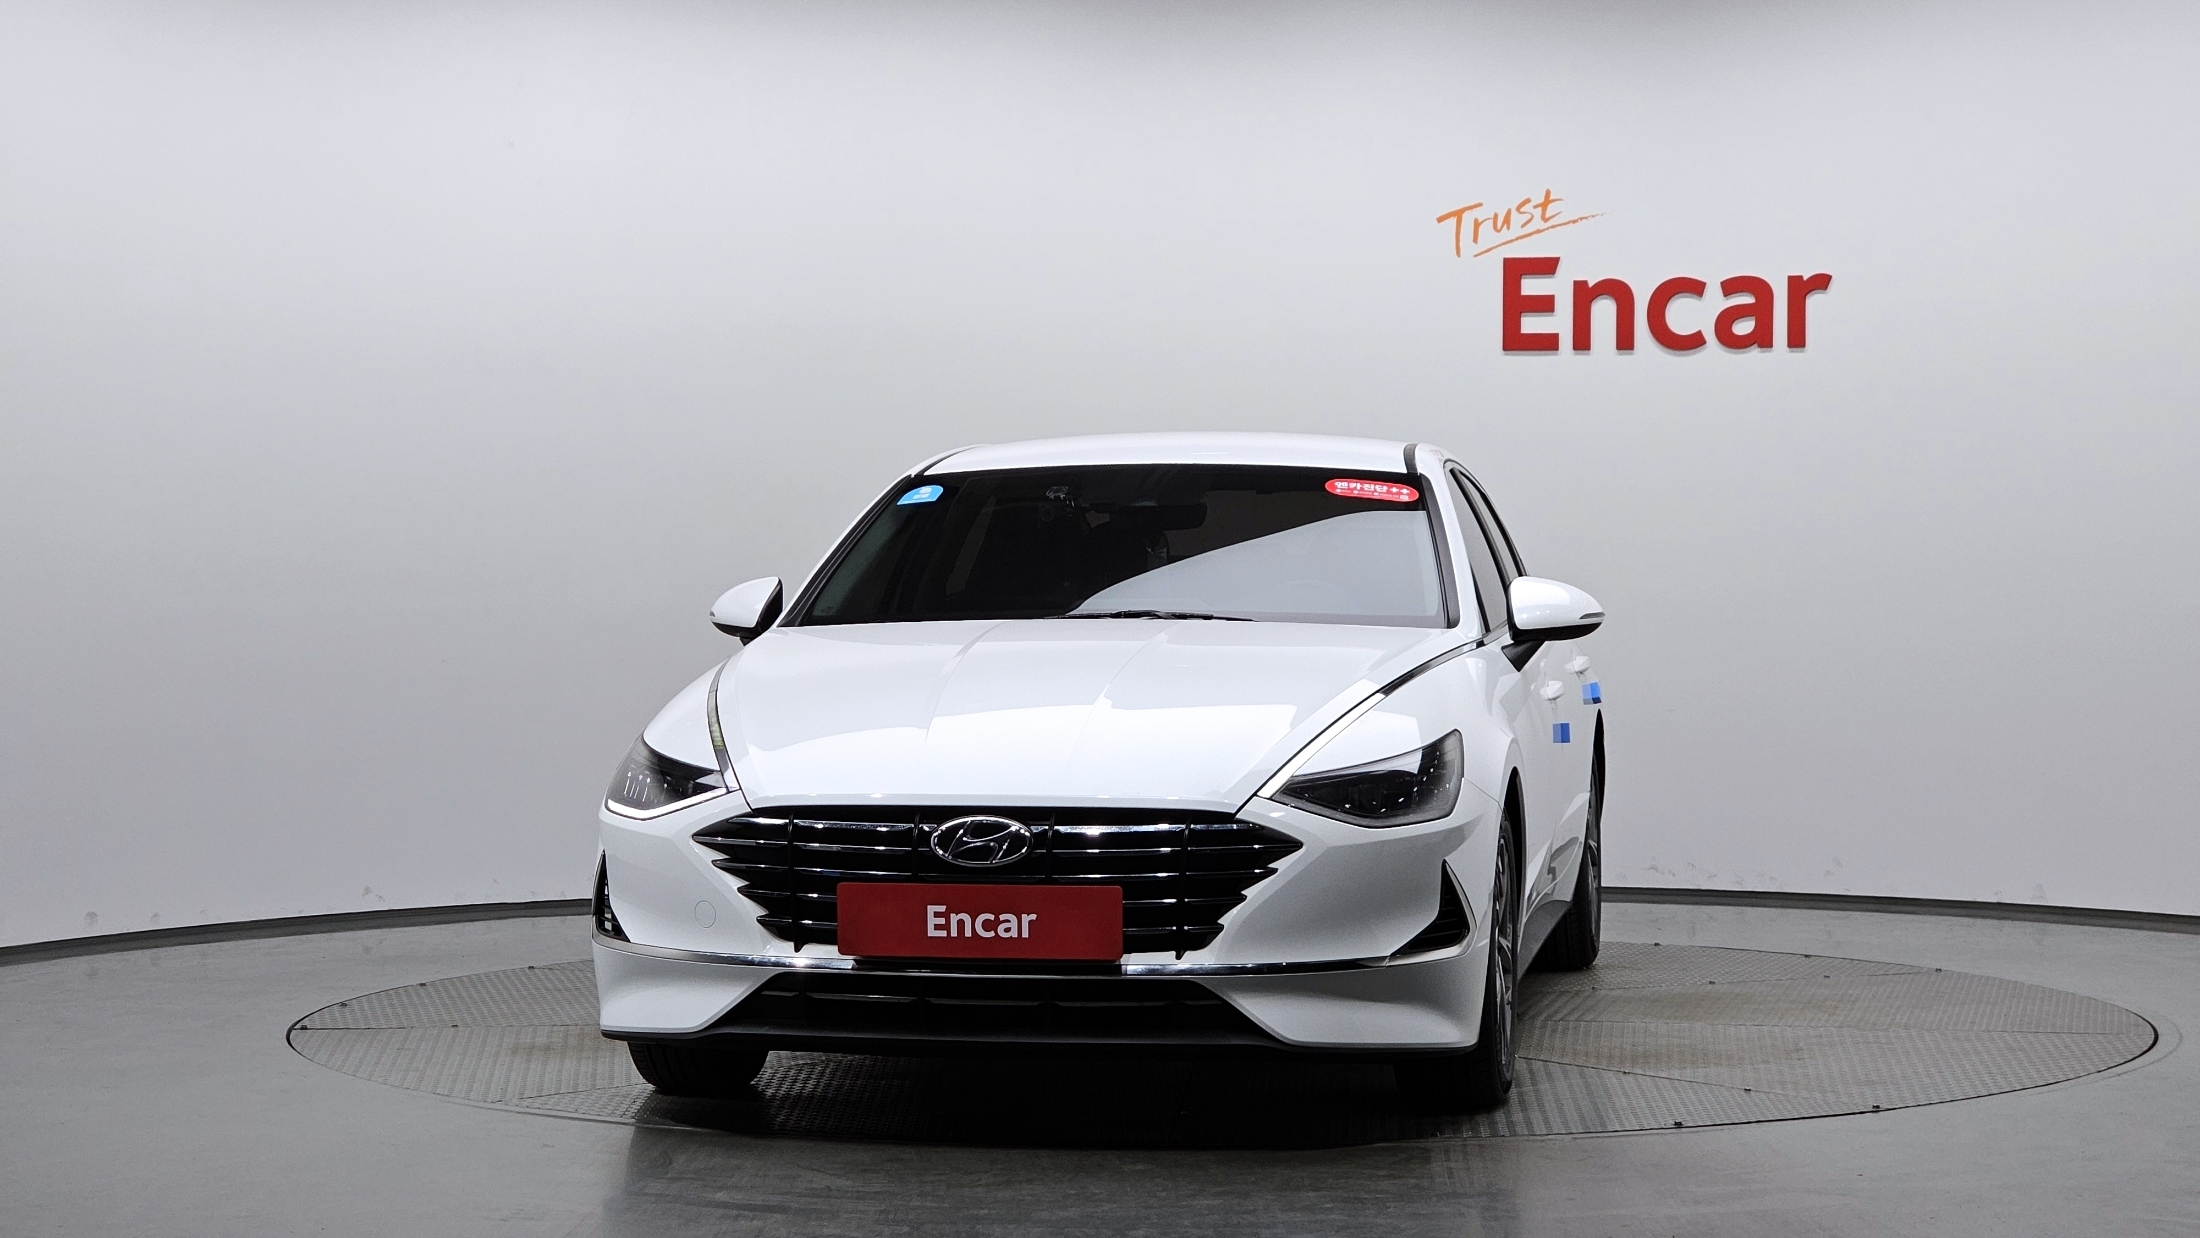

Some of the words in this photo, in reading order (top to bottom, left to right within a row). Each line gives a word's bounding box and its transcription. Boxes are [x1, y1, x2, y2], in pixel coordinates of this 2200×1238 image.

[1436, 188, 1564, 258] Trust
[1502, 256, 1833, 352] Encar
[926, 904, 1037, 938] Encar
